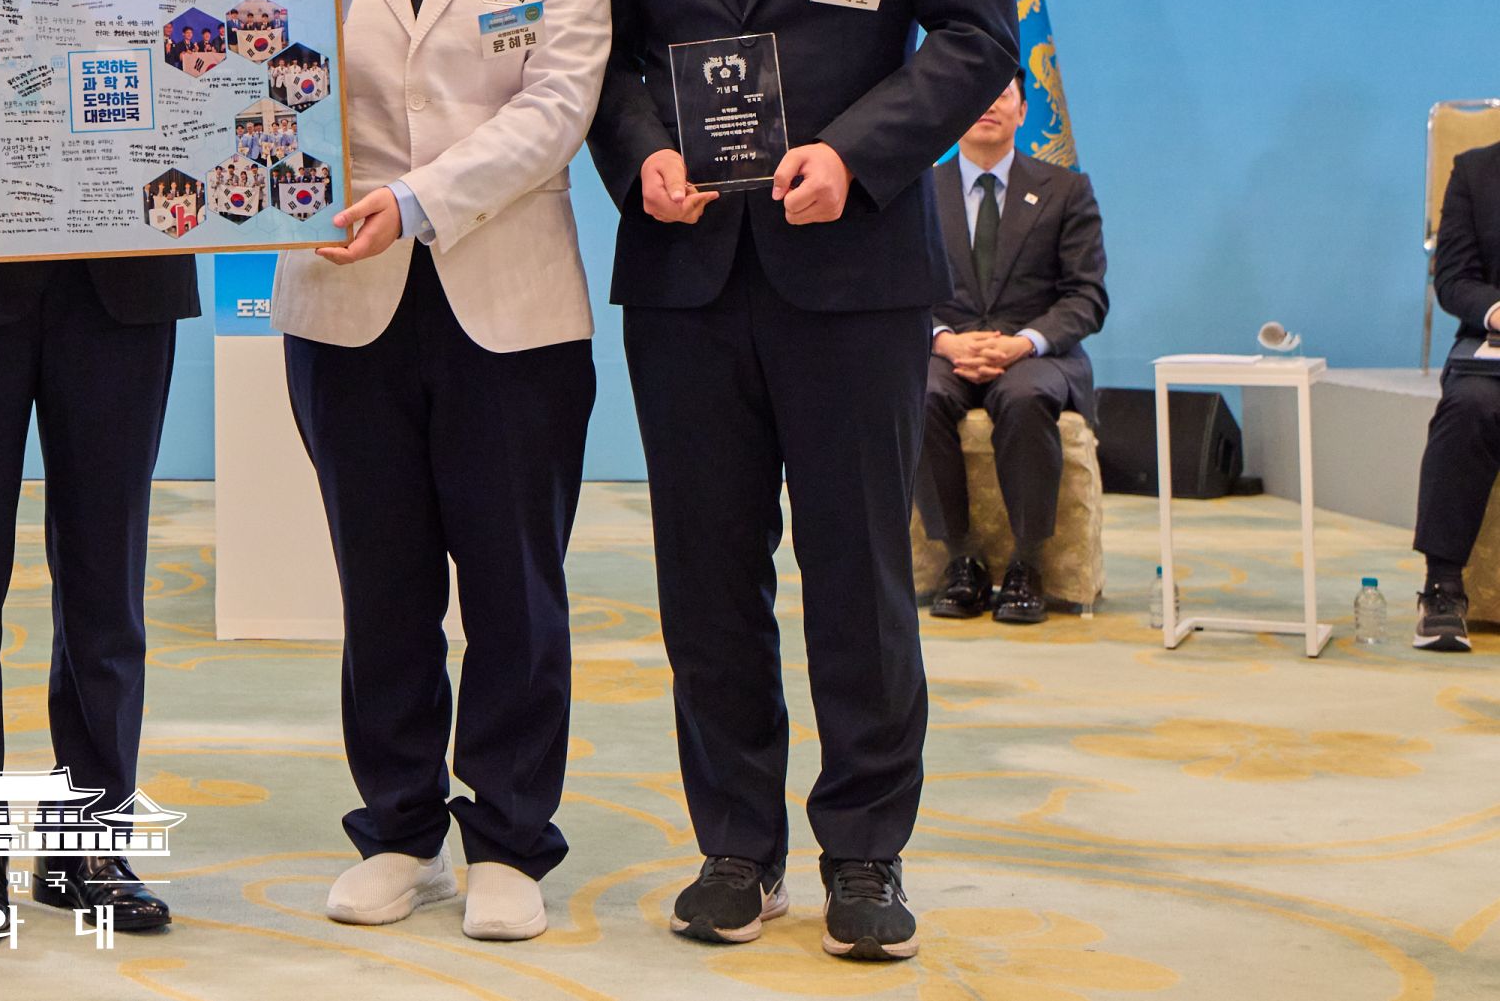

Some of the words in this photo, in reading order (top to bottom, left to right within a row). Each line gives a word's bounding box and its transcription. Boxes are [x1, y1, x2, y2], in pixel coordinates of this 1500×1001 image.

[82, 60, 138, 75] 도전하는
[83, 92, 139, 107] 도약하는
[84, 107, 140, 123] 대한민국
